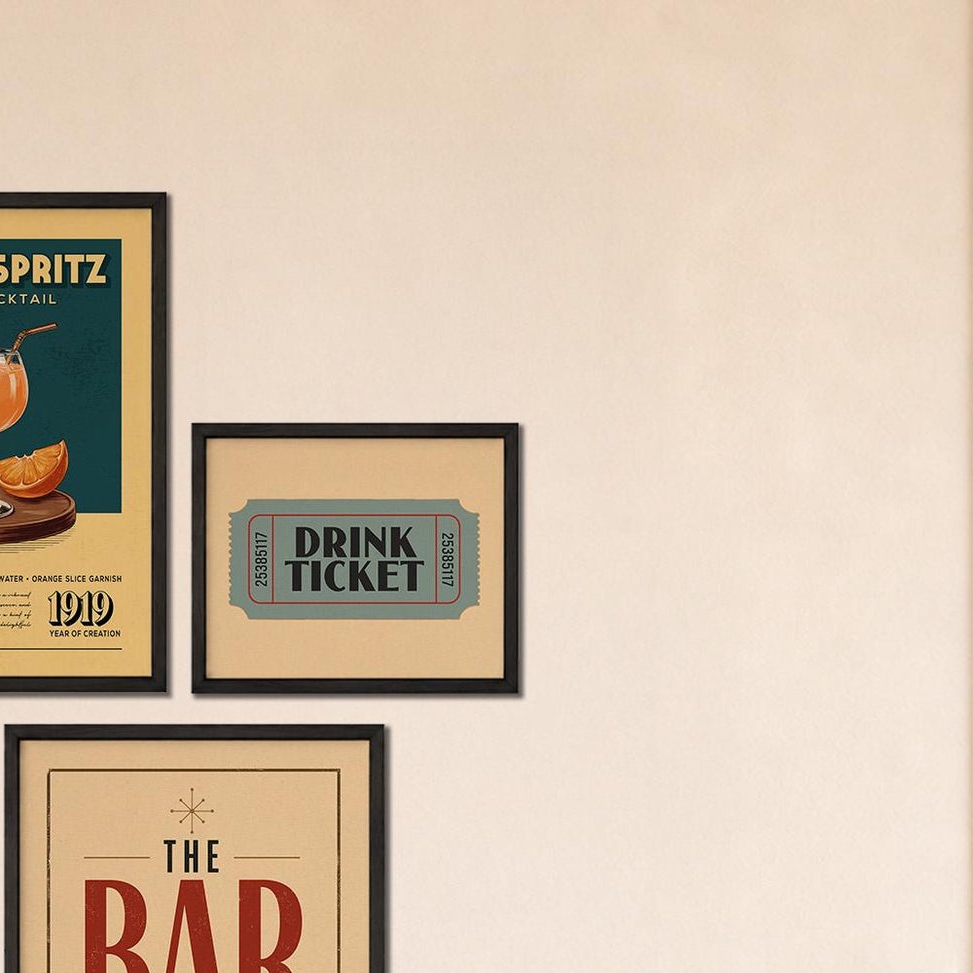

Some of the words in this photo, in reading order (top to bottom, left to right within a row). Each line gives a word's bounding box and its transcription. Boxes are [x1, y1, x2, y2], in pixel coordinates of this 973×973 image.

[295, 526, 418, 558] DRINK
[255, 532, 268, 587] 25385117
[284, 560, 425, 592] TICKET
[441, 532, 455, 587] 25385117
[31, 575, 63, 583] ORANGE
[65, 575, 87, 583] SLICE
[88, 575, 122, 583] GARNISH
[47, 590, 115, 627] 1919
[49, 630, 70, 638] YEAR
[71, 630, 82, 638] OF
[83, 630, 121, 638] CREATION
[163, 839, 220, 873] THE
